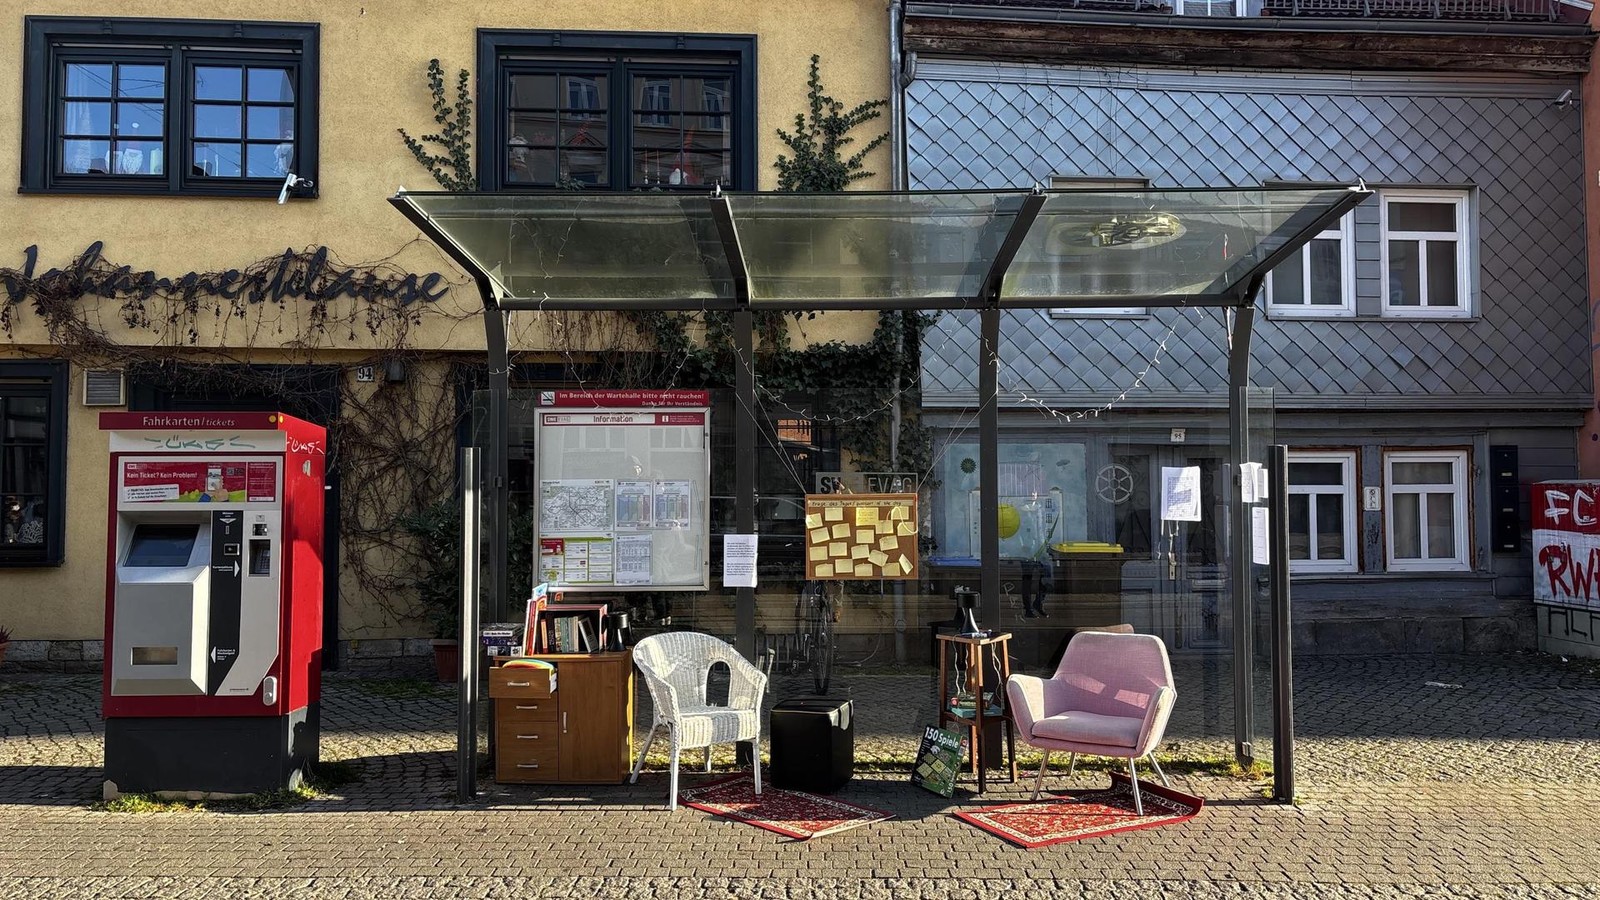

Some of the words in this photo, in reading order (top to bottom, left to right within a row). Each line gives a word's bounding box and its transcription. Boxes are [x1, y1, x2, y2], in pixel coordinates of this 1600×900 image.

[358, 367, 373, 380] 94
[142, 416, 200, 426] Fahrkarten
[593, 415, 634, 423] Information
[1544, 488, 1598, 526] FC
[924, 726, 939, 741] 150
[937, 732, 959, 749] Spiele
